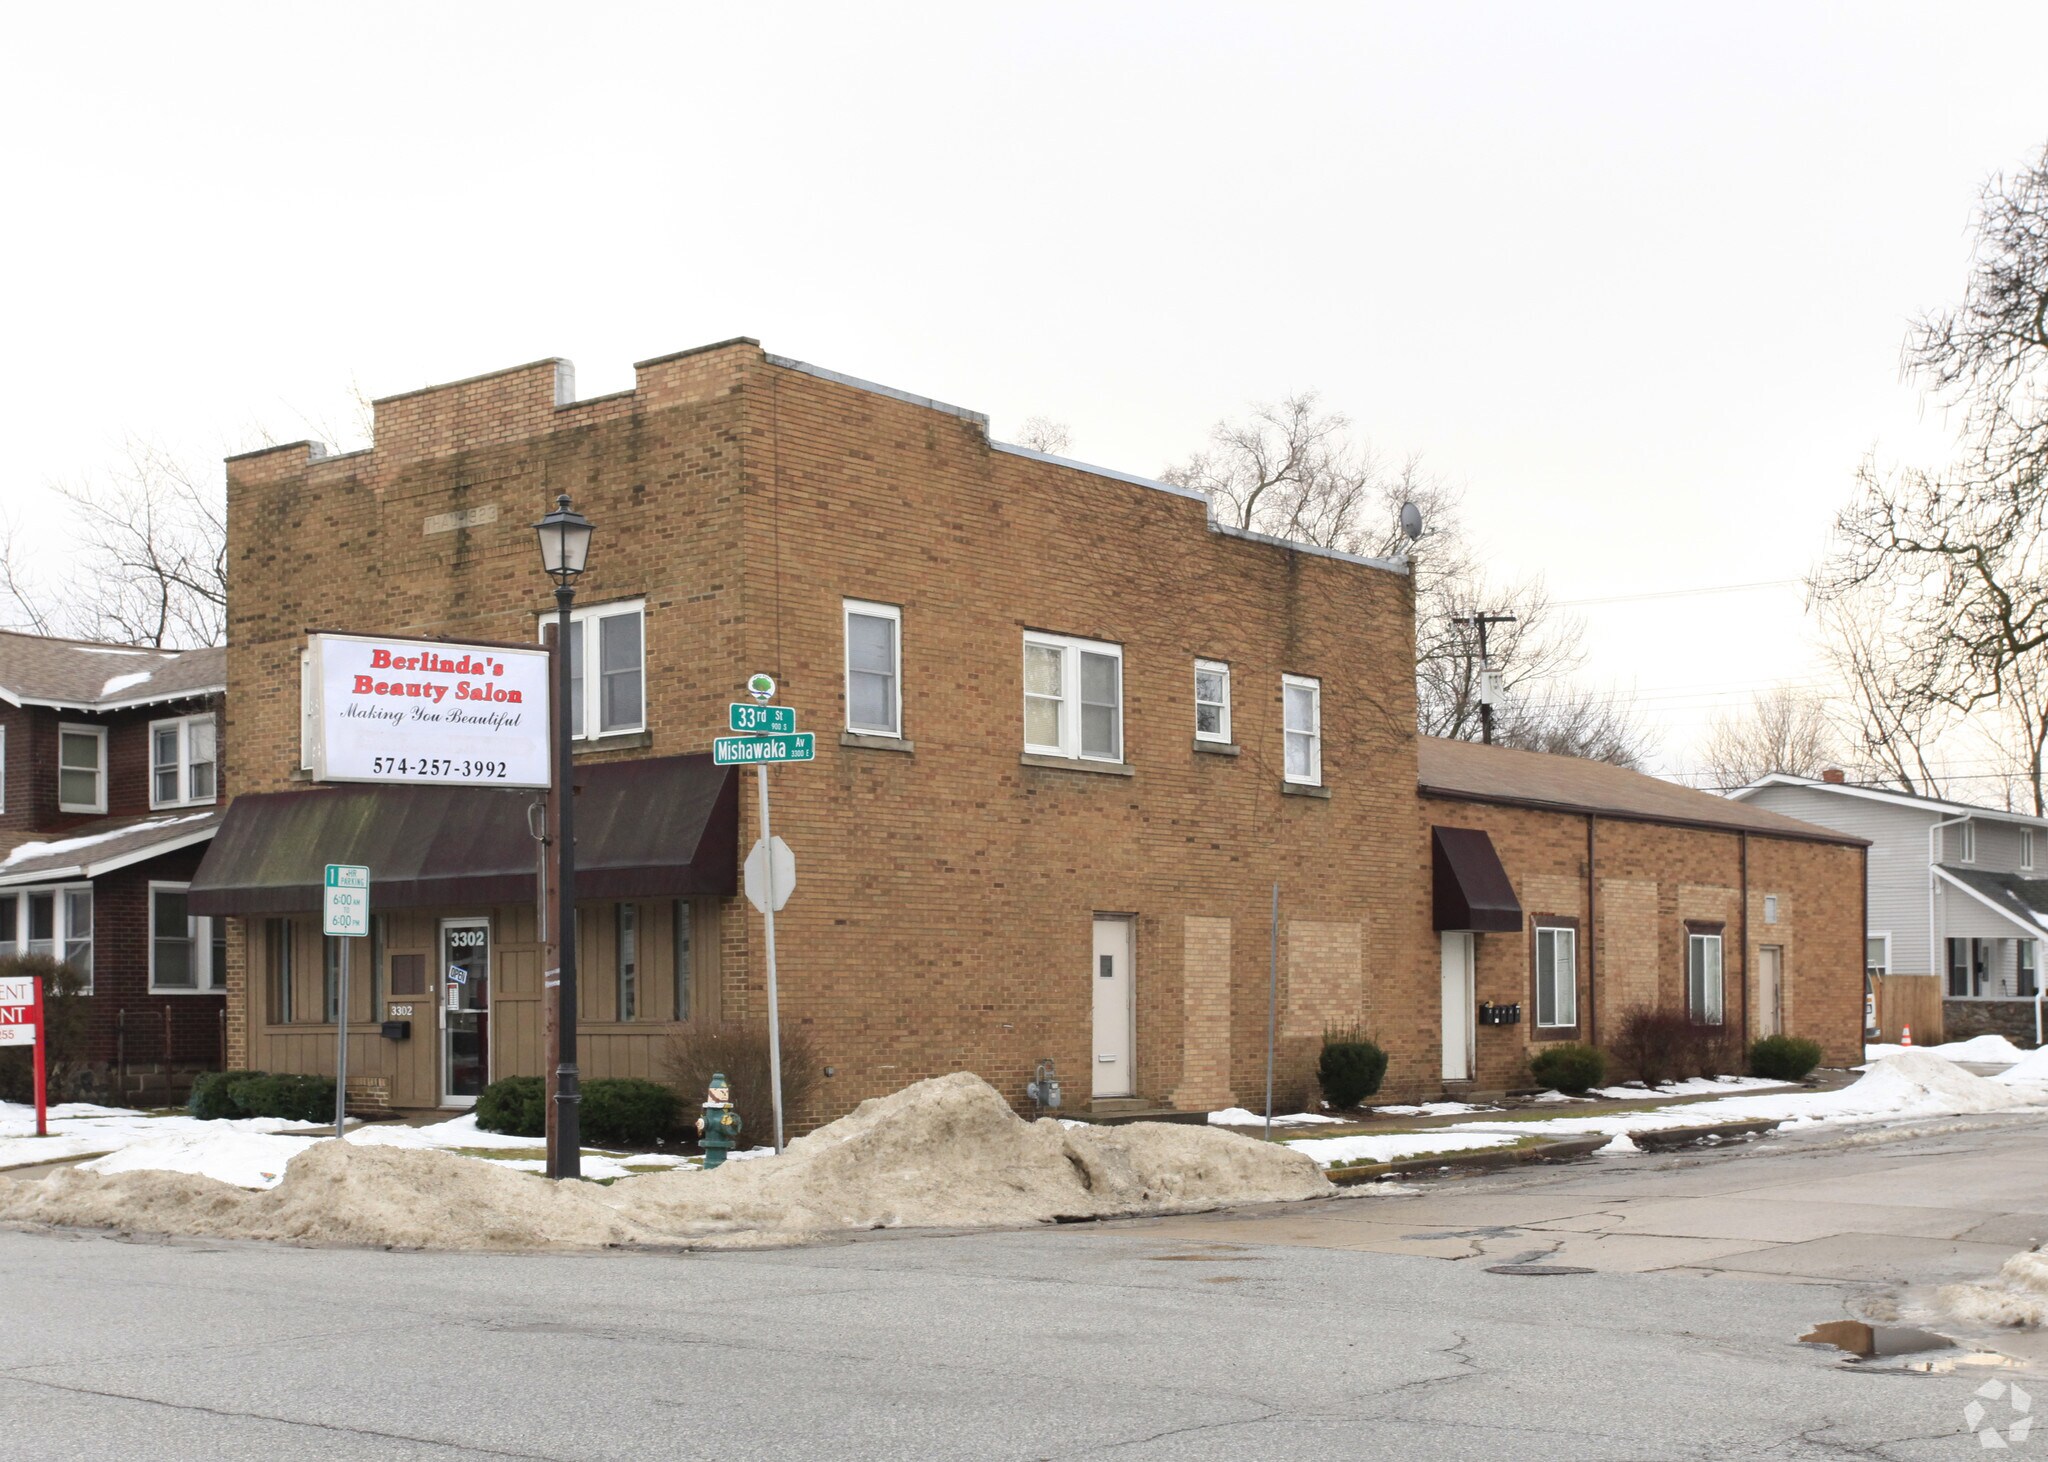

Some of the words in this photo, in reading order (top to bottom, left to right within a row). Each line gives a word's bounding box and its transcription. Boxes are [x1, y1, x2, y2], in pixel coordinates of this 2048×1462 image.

[370, 649, 504, 676] Berlinda's
[352, 675, 449, 704] Beauty
[455, 681, 522, 704] Salon
[340, 703, 406, 727] Making
[410, 705, 442, 723] You
[445, 708, 522, 731] Beautiful
[738, 708, 767, 728] 33rd
[775, 710, 783, 721] St
[771, 723, 782, 731] 900
[718, 739, 786, 760] Mishawaka
[796, 737, 805, 747] Av
[373, 757, 507, 778] 574-257-3992
[341, 877, 364, 886] PARKING
[333, 894, 352, 905] 6:00
[332, 915, 352, 926] 6:00
[451, 931, 485, 947] 3302
[451, 967, 466, 981] OPEN
[391, 1006, 413, 1016] 3302
